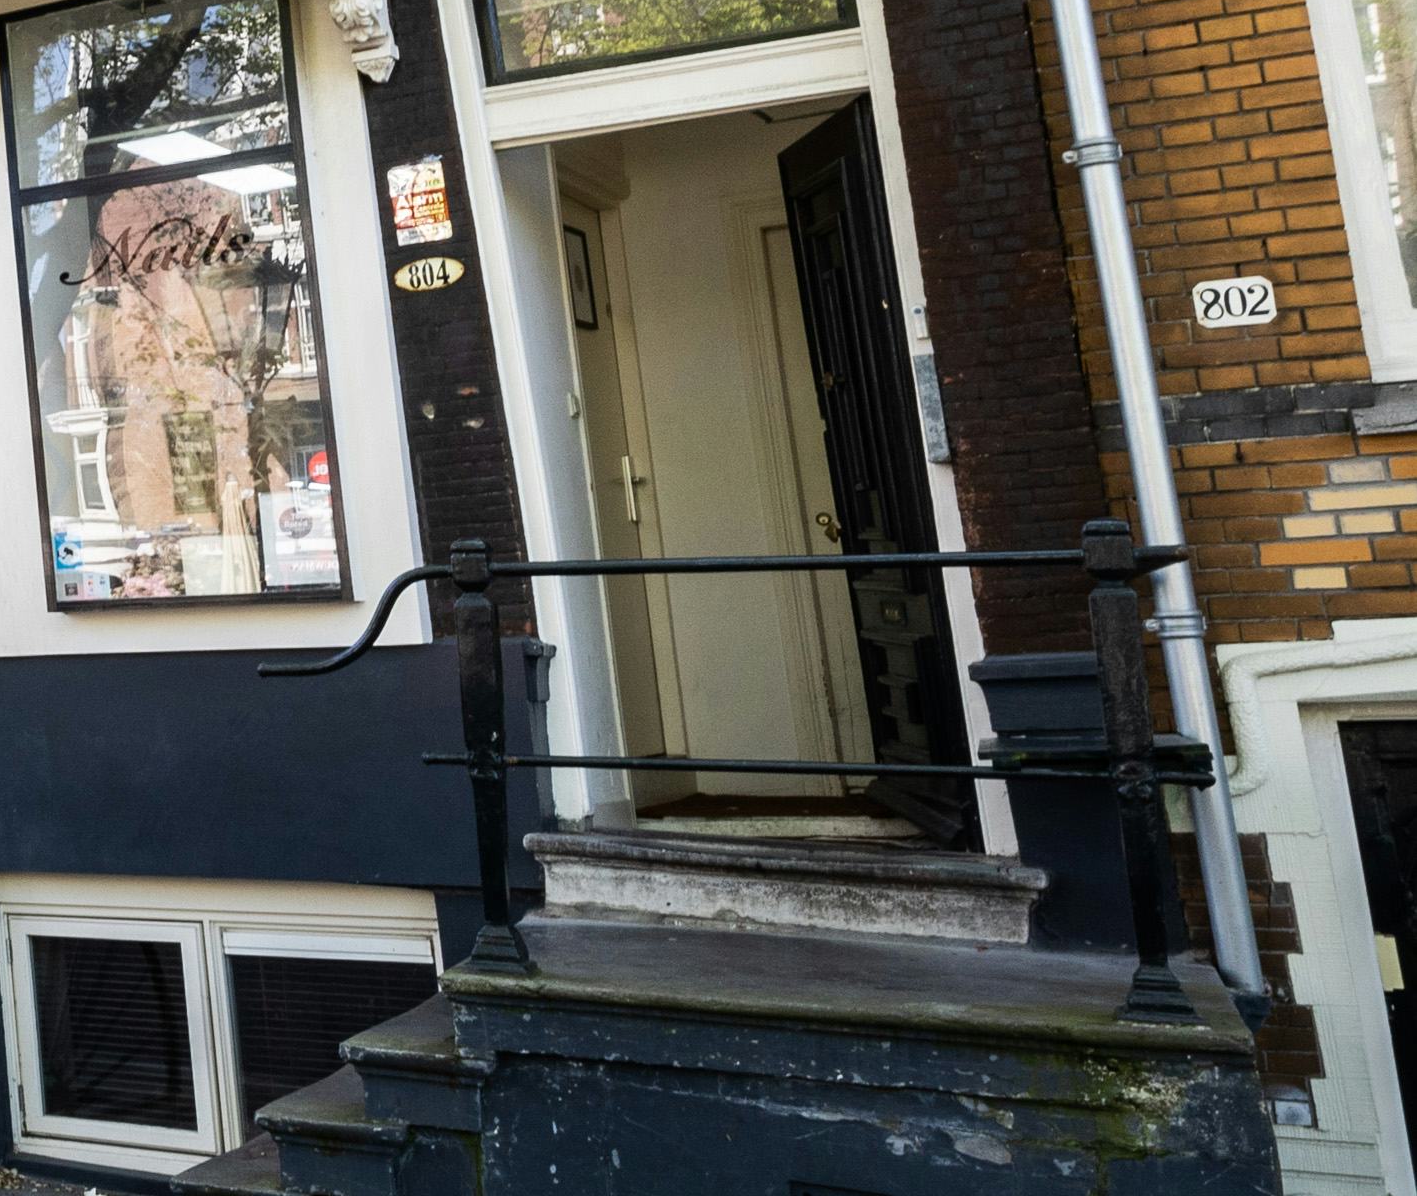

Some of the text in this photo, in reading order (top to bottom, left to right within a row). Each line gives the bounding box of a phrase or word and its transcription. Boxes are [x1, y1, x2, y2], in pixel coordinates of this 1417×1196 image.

[60, 213, 254, 285] Nails
[408, 260, 450, 288] 804
[1199, 284, 1270, 320] 802
